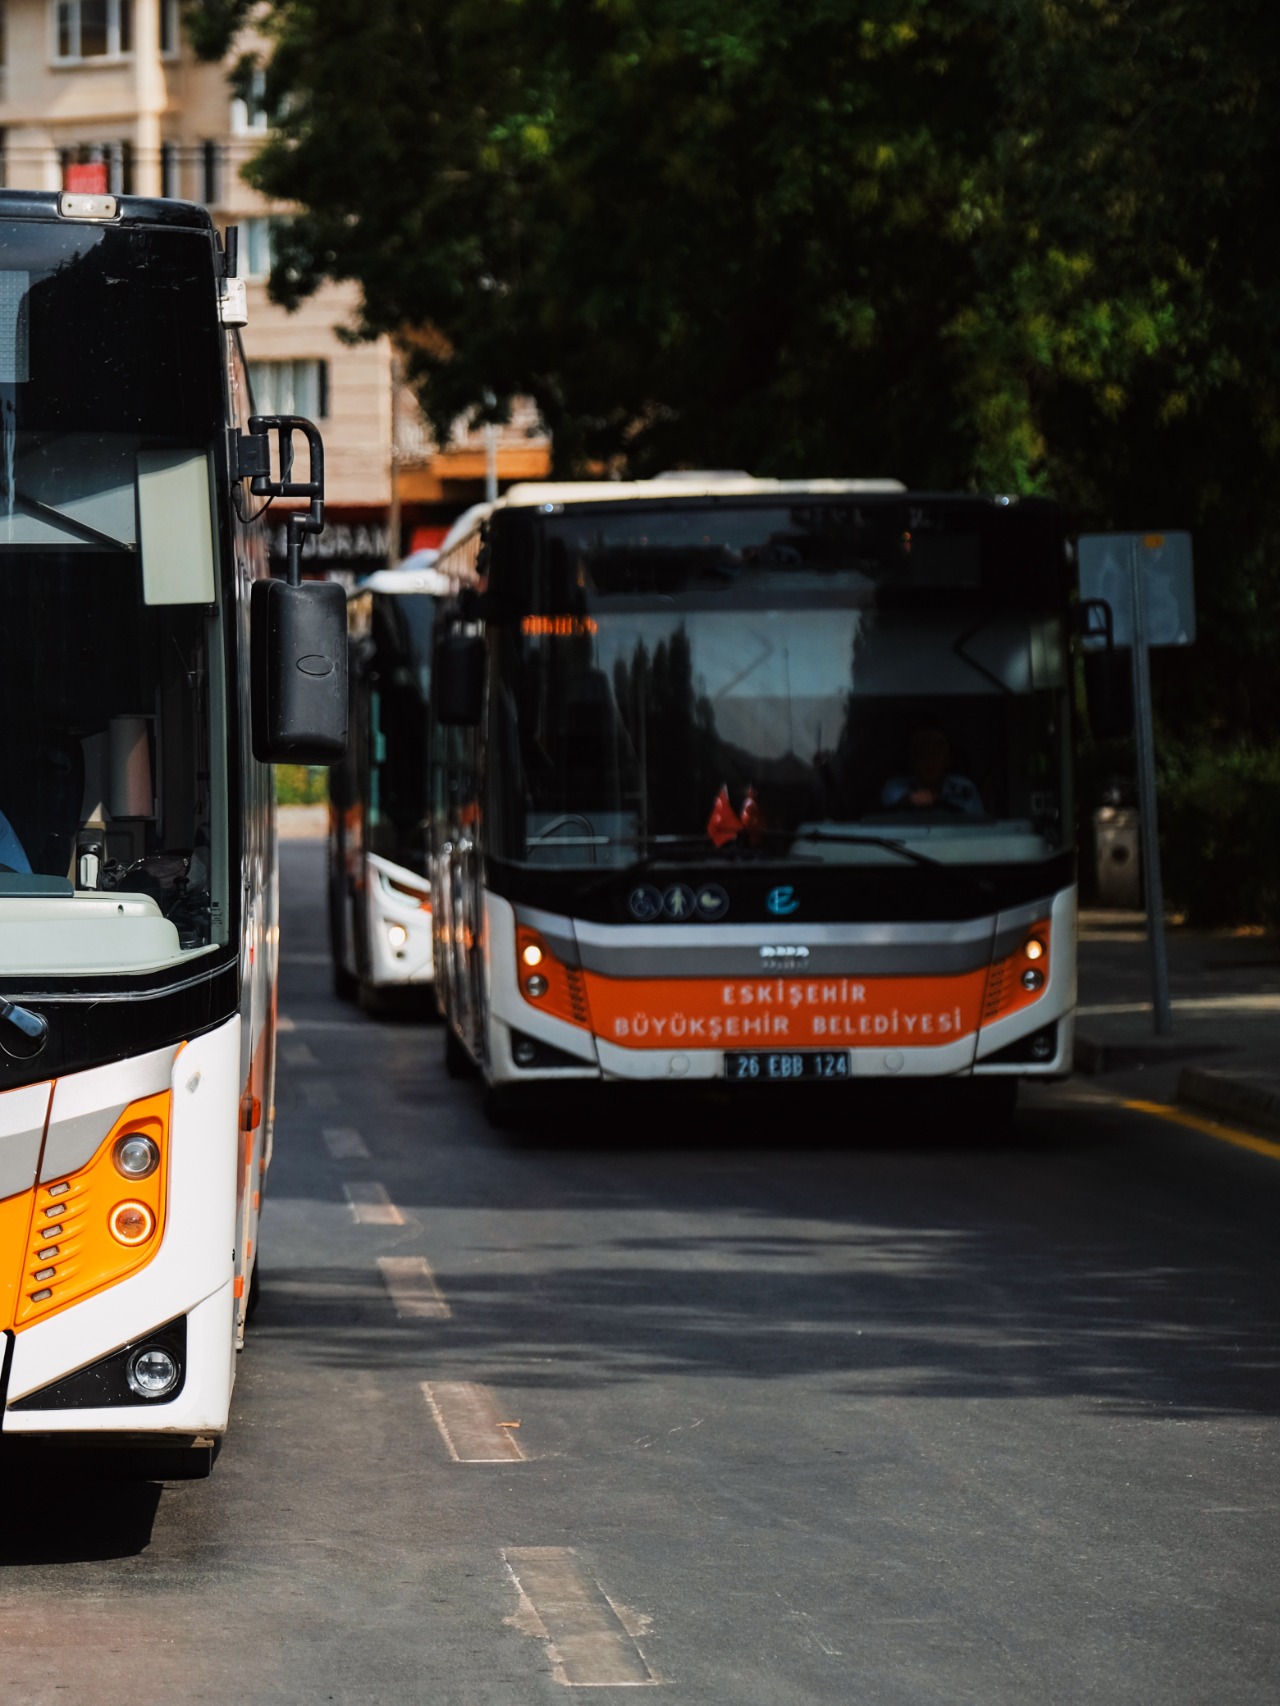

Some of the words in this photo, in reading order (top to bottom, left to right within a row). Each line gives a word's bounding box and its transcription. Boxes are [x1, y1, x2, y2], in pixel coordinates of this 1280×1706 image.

[722, 978, 867, 1009] ESKİŞEHİR
[614, 1012, 791, 1040] BÜYÜKŞEHİR
[812, 1006, 962, 1035] BELEDİYESİ
[738, 1055, 760, 1078] 26
[768, 1055, 804, 1078] EBB
[815, 1054, 847, 1076] 124
